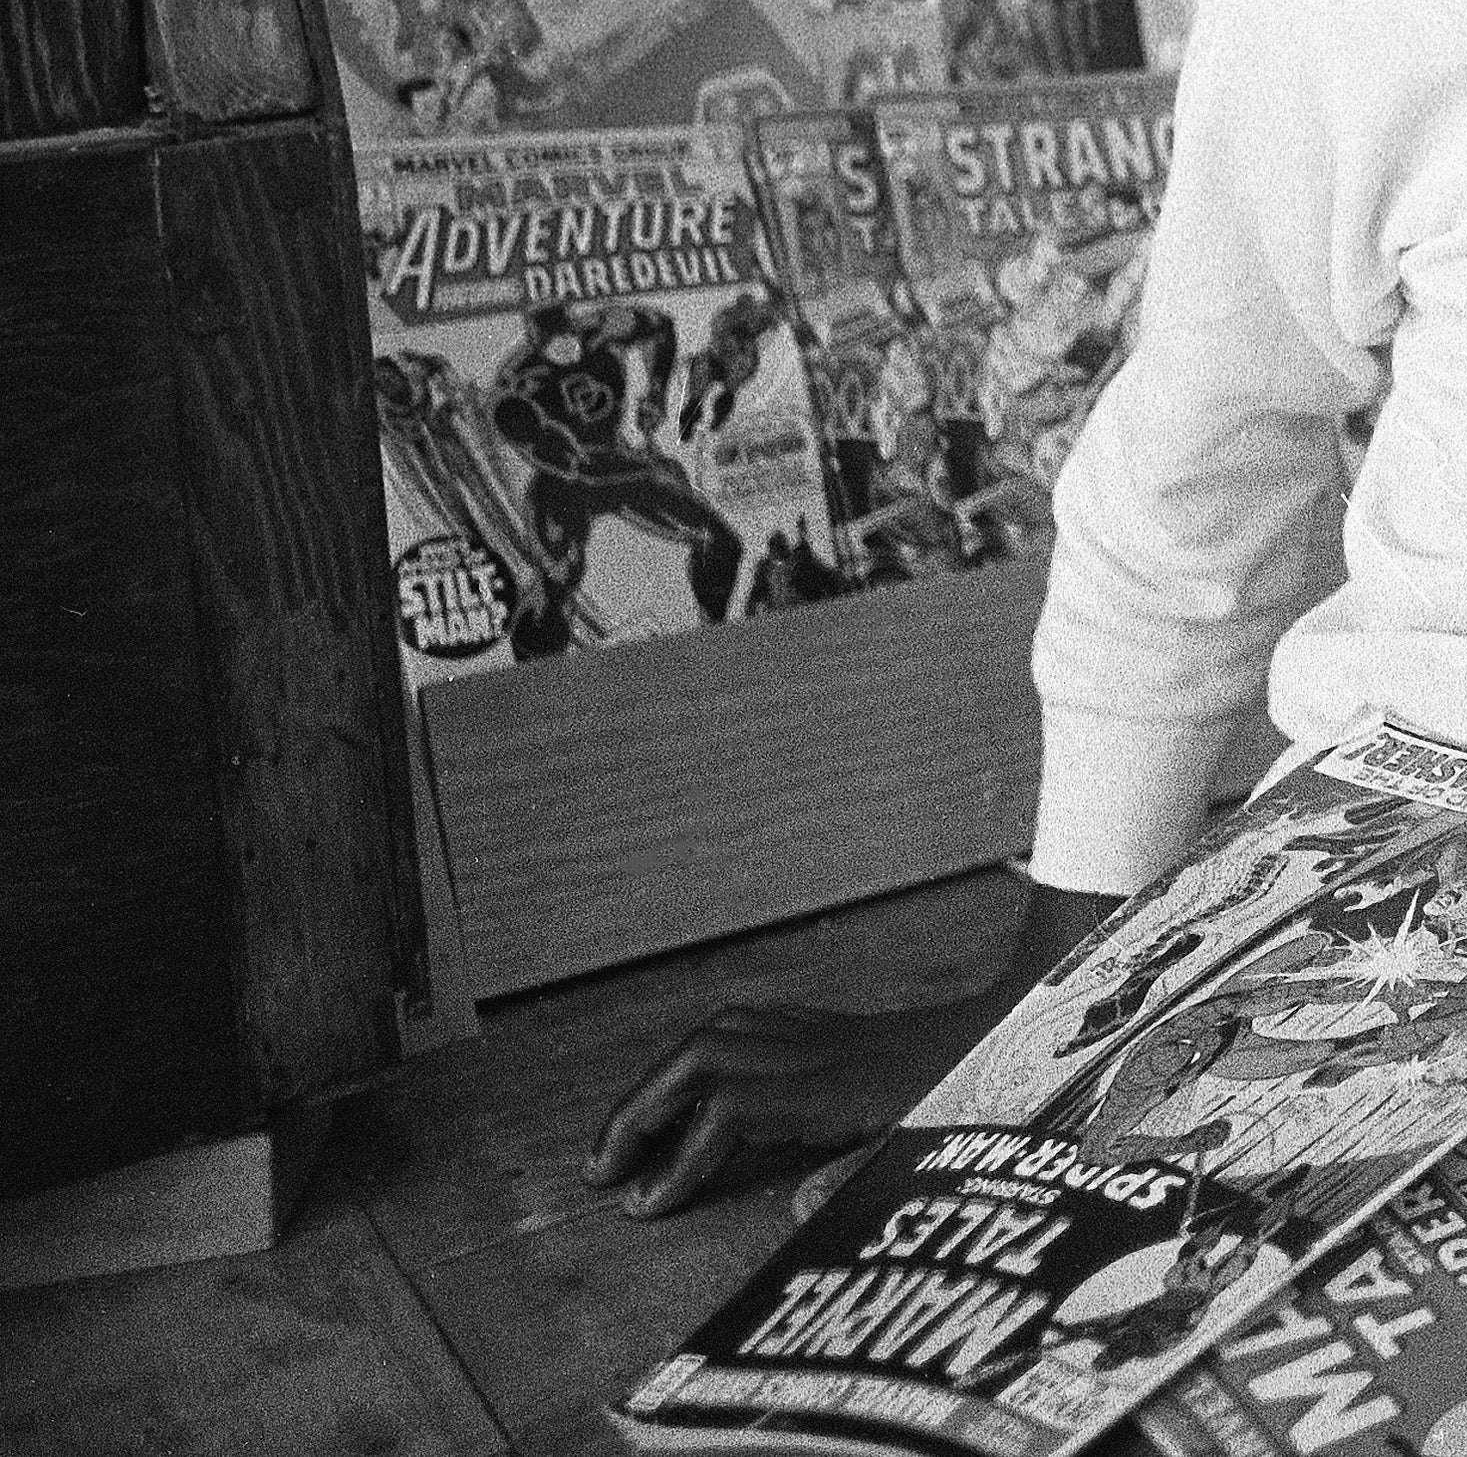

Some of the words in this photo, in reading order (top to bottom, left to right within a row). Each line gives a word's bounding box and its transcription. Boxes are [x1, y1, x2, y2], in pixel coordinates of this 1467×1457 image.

[386, 195, 739, 313] ADVENTURE
[523, 247, 740, 303] DAREDEVIL
[914, 1131, 1187, 1210] SPIDER-MAN!
[859, 1195, 1072, 1276] TALES
[736, 1265, 1051, 1377] MARVEL
